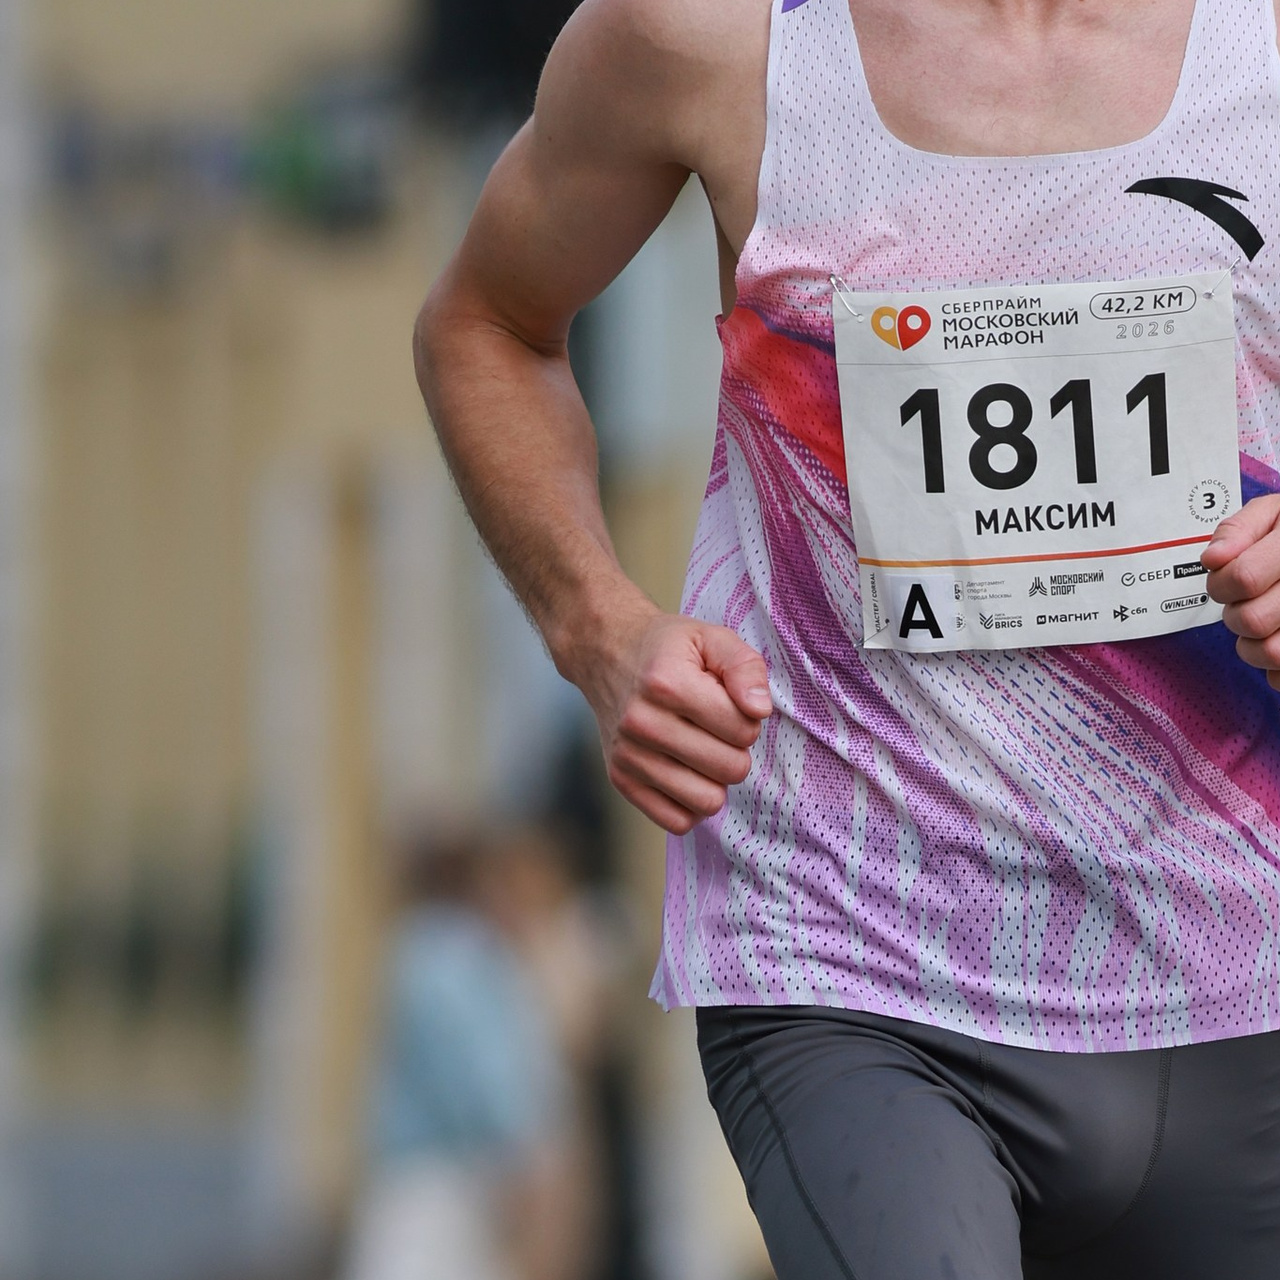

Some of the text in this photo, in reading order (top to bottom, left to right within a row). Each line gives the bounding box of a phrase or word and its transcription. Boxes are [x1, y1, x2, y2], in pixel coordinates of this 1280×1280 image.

[941, 296, 1043, 315] СБЕРПРАЙМ
[1101, 291, 1184, 315] 42,2 КМ
[942, 309, 1080, 332] МОСКОВСКИЙ
[1115, 320, 1176, 340] 2026
[943, 329, 1045, 350] МАРАФОН
[900, 372, 1171, 494] 1811
[1202, 492, 1216, 510] 3
[974, 501, 1116, 535] МАКСИМ
[1050, 570, 1105, 585] МОСКОВСКИЙ
[1138, 564, 1204, 583] СБЕР Прайм
[1050, 584, 1077, 596] СПОРТ
[1164, 597, 1200, 610] WINLINE
[994, 620, 1024, 630] BRICS
